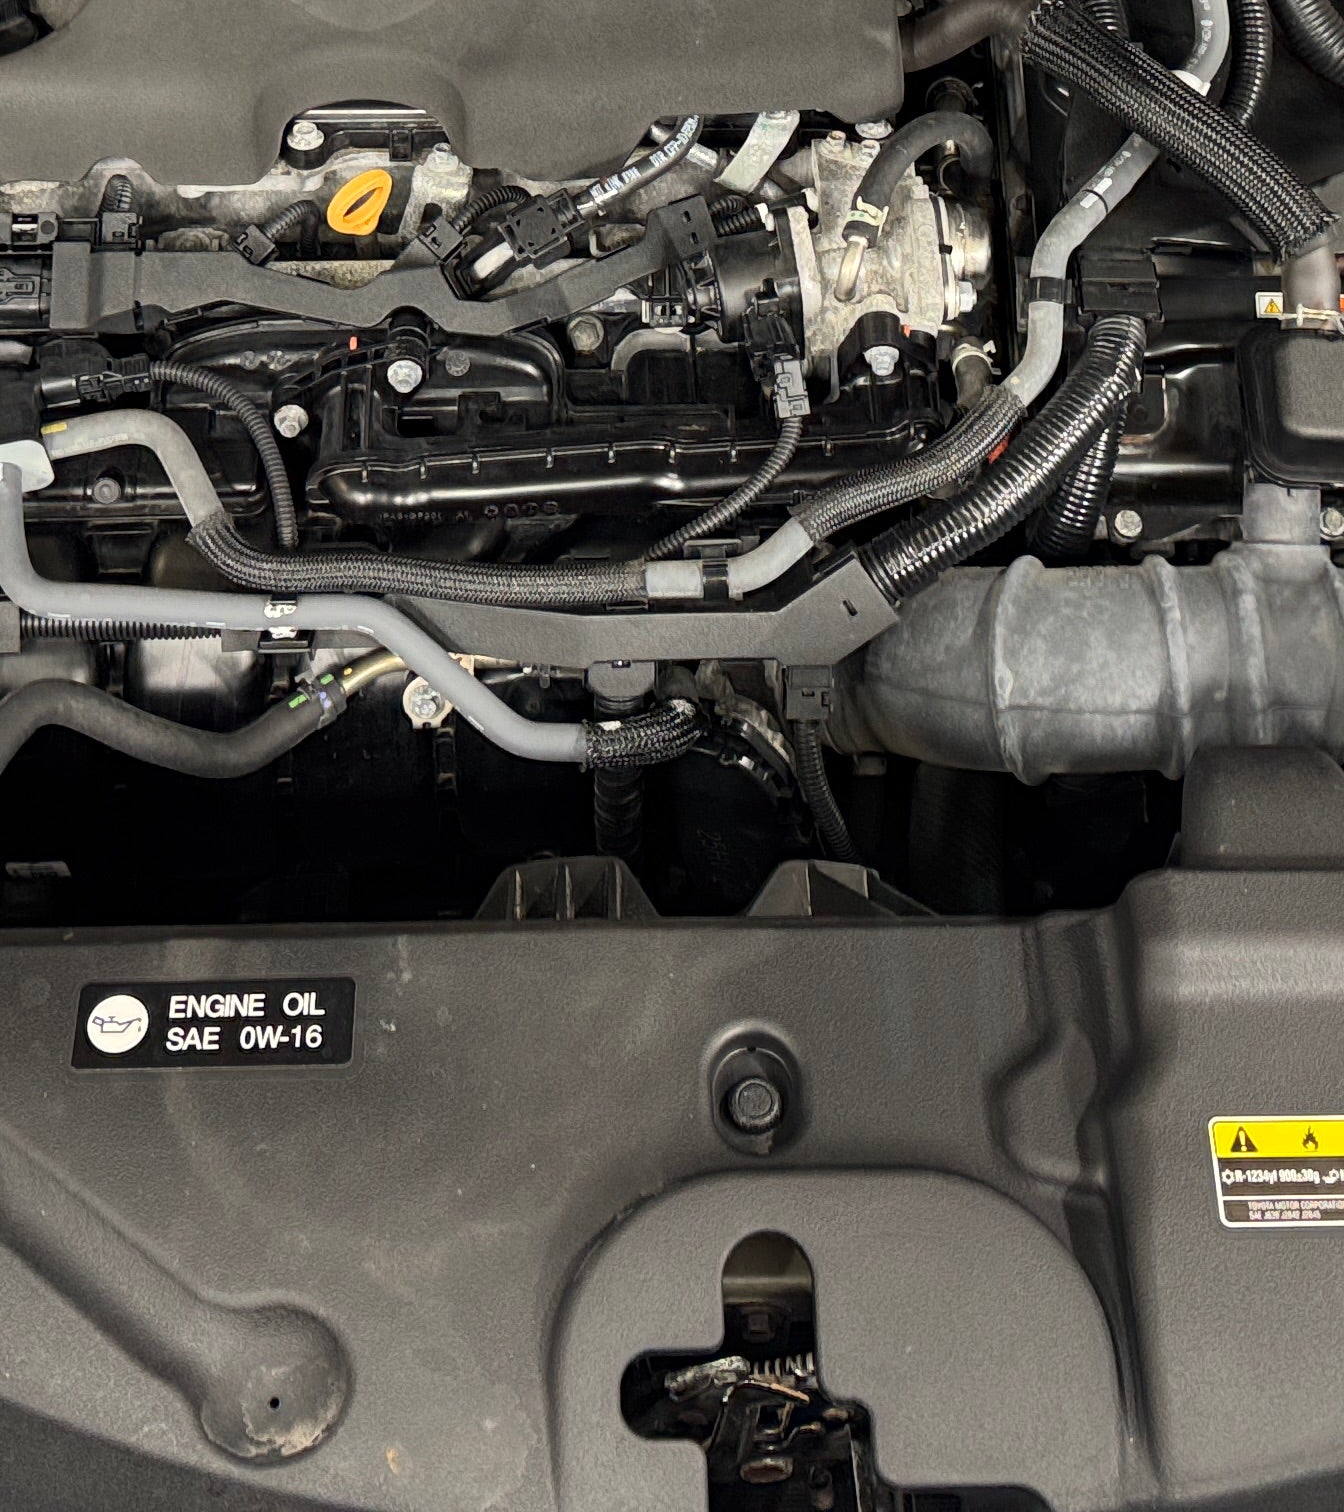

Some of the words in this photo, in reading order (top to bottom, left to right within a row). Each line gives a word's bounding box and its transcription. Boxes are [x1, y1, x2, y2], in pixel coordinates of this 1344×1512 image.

[168, 993, 266, 1019] ENGINE
[282, 991, 326, 1017] OIL
[165, 1026, 220, 1052] SAE
[239, 1024, 323, 1051] 0W-16
